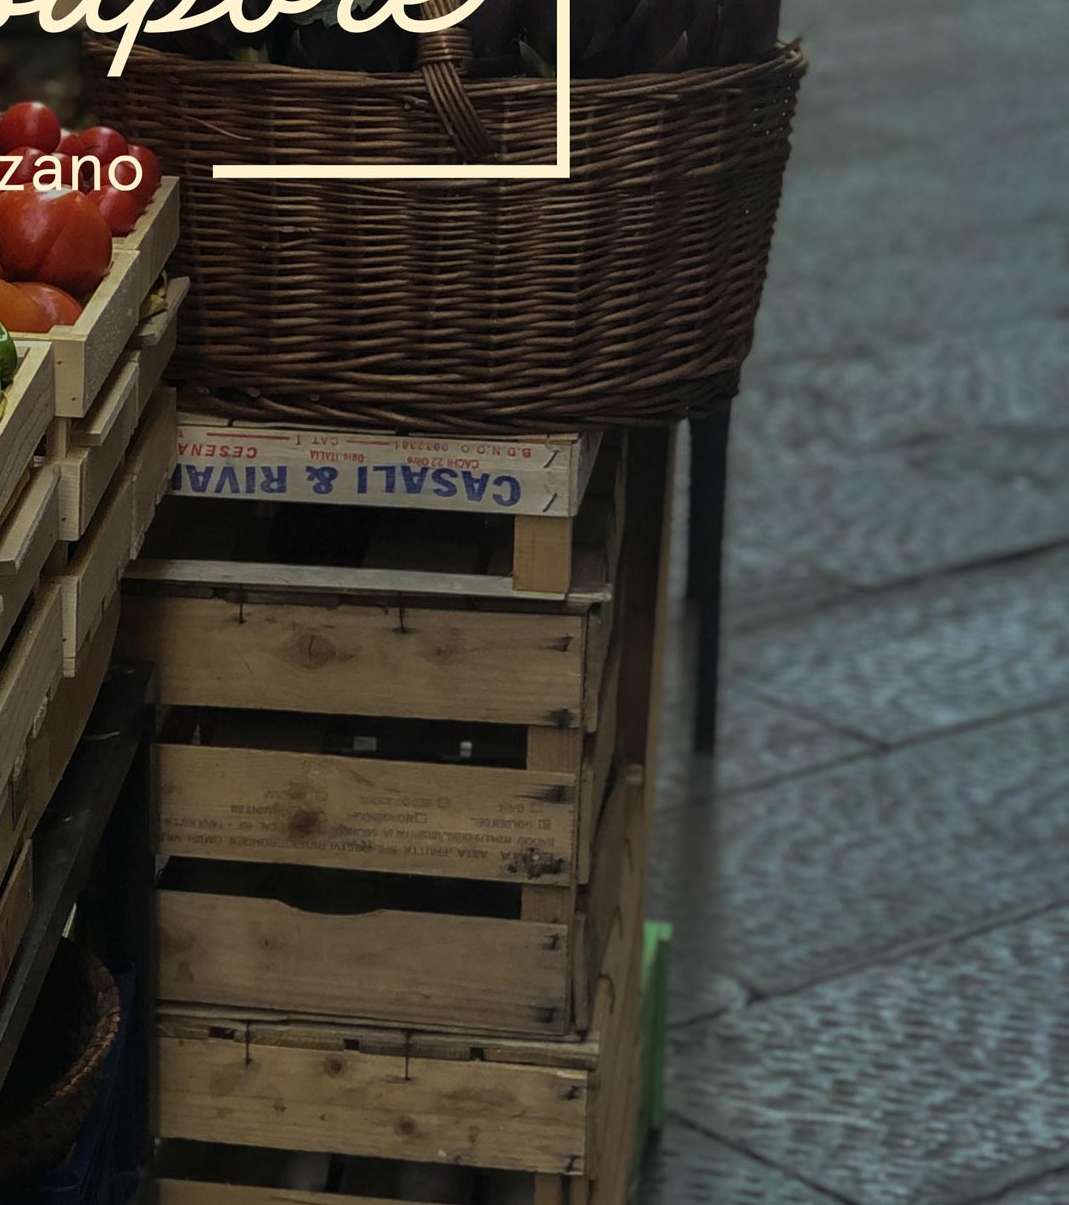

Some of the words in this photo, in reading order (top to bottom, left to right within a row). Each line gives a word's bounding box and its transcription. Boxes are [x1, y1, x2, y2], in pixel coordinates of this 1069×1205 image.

[176, 442, 258, 460] CESENA
[309, 448, 338, 462] ITALIA
[431, 456, 444, 468] 22
[446, 456, 480, 470] CACHI
[305, 464, 339, 495] &
[356, 464, 522, 508] CASALI
